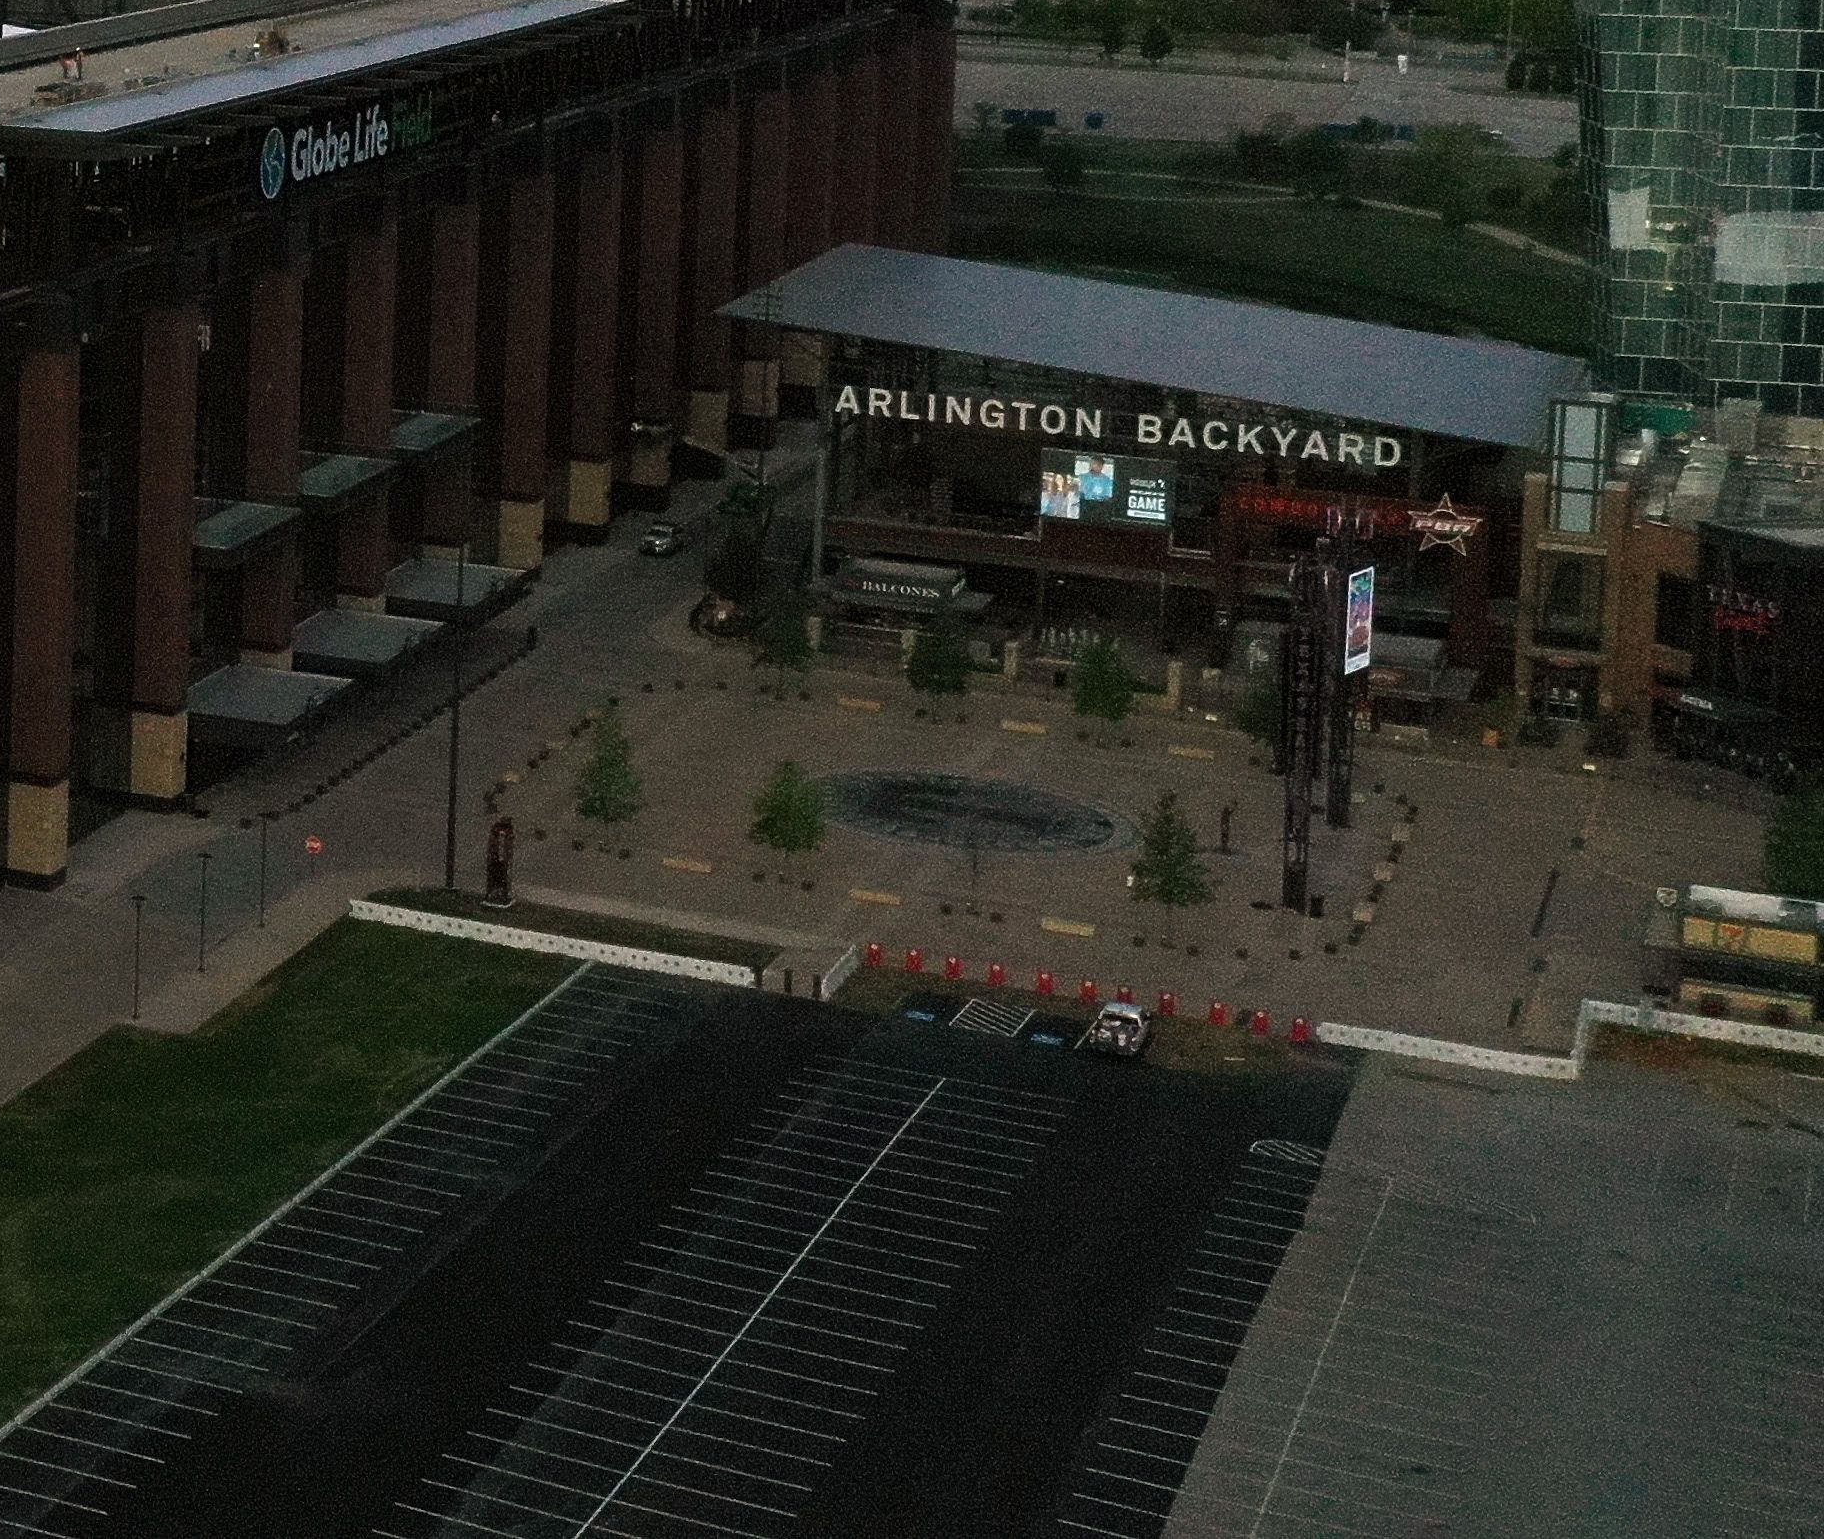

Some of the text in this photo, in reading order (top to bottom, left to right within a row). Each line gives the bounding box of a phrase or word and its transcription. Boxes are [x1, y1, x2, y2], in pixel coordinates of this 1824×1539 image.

[291, 121, 350, 181] Globe
[353, 104, 389, 163] Life
[834, 385, 1401, 467] ARLINGTON BACKYARD
[1128, 495, 1166, 512] GAME
[862, 580, 940, 598] BALCONES
